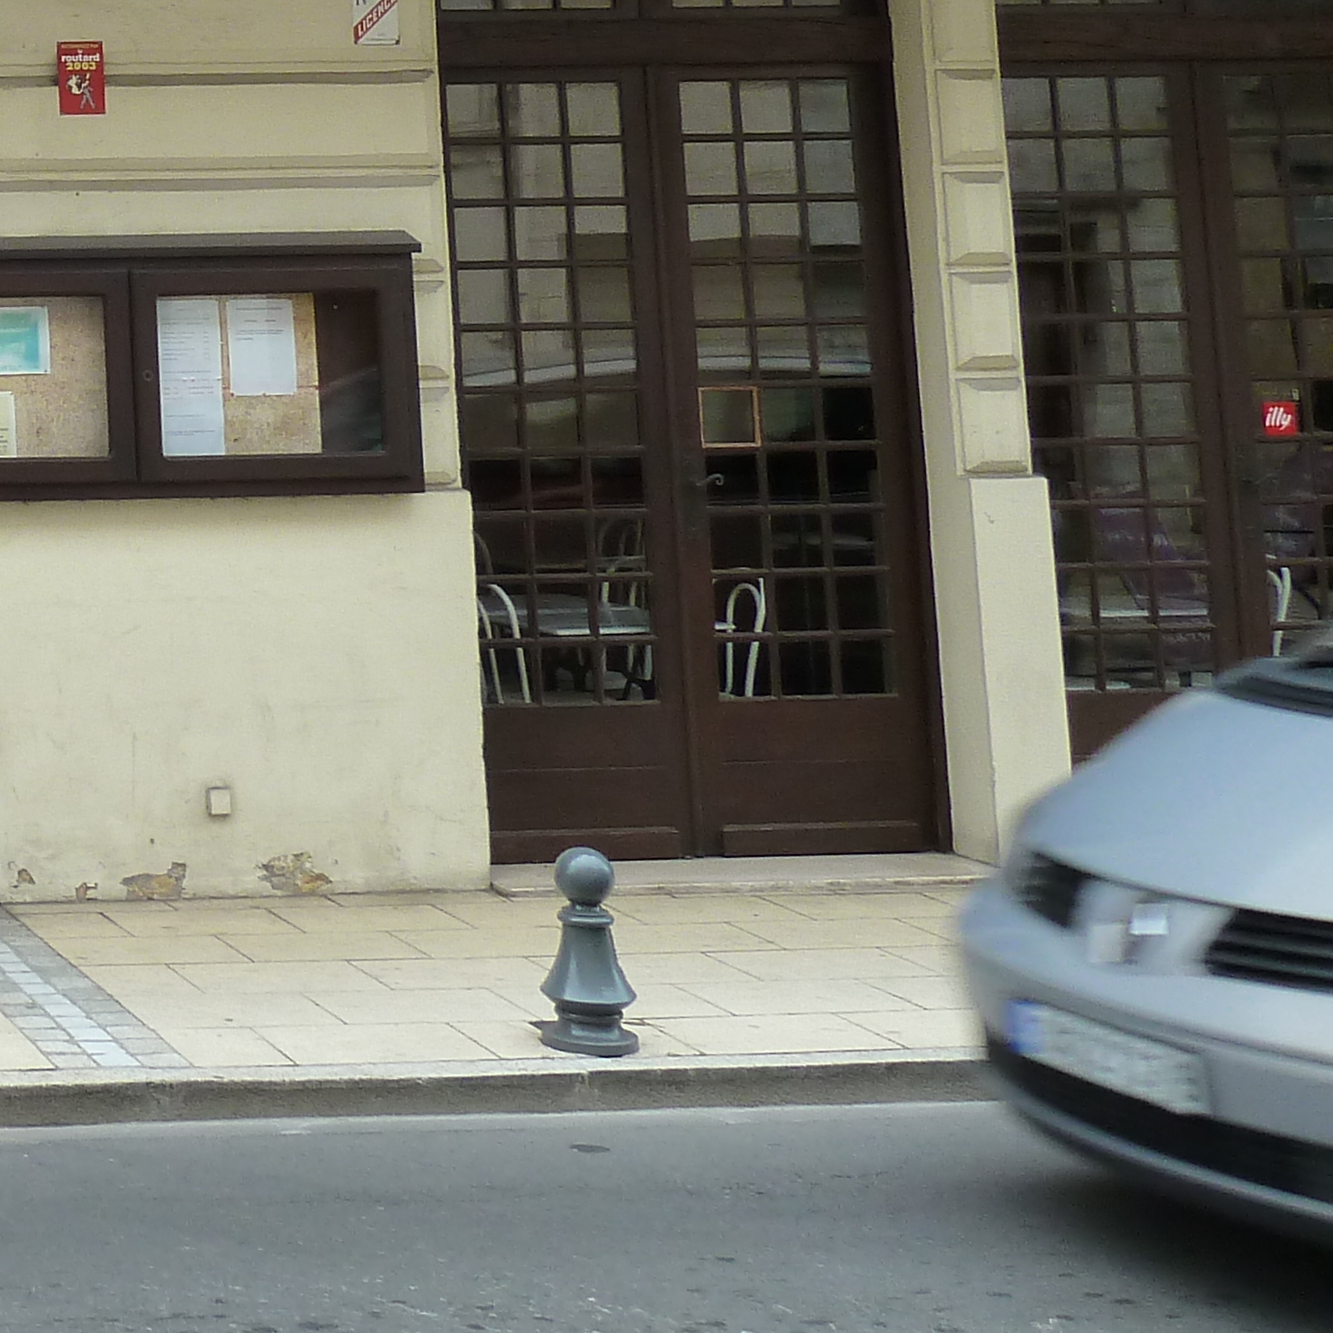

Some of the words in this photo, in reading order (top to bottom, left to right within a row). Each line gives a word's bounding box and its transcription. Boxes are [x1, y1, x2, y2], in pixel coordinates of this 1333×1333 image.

[61, 53, 100, 62] routard
[65, 62, 97, 70] 2003
[1265, 406, 1292, 431] illy
